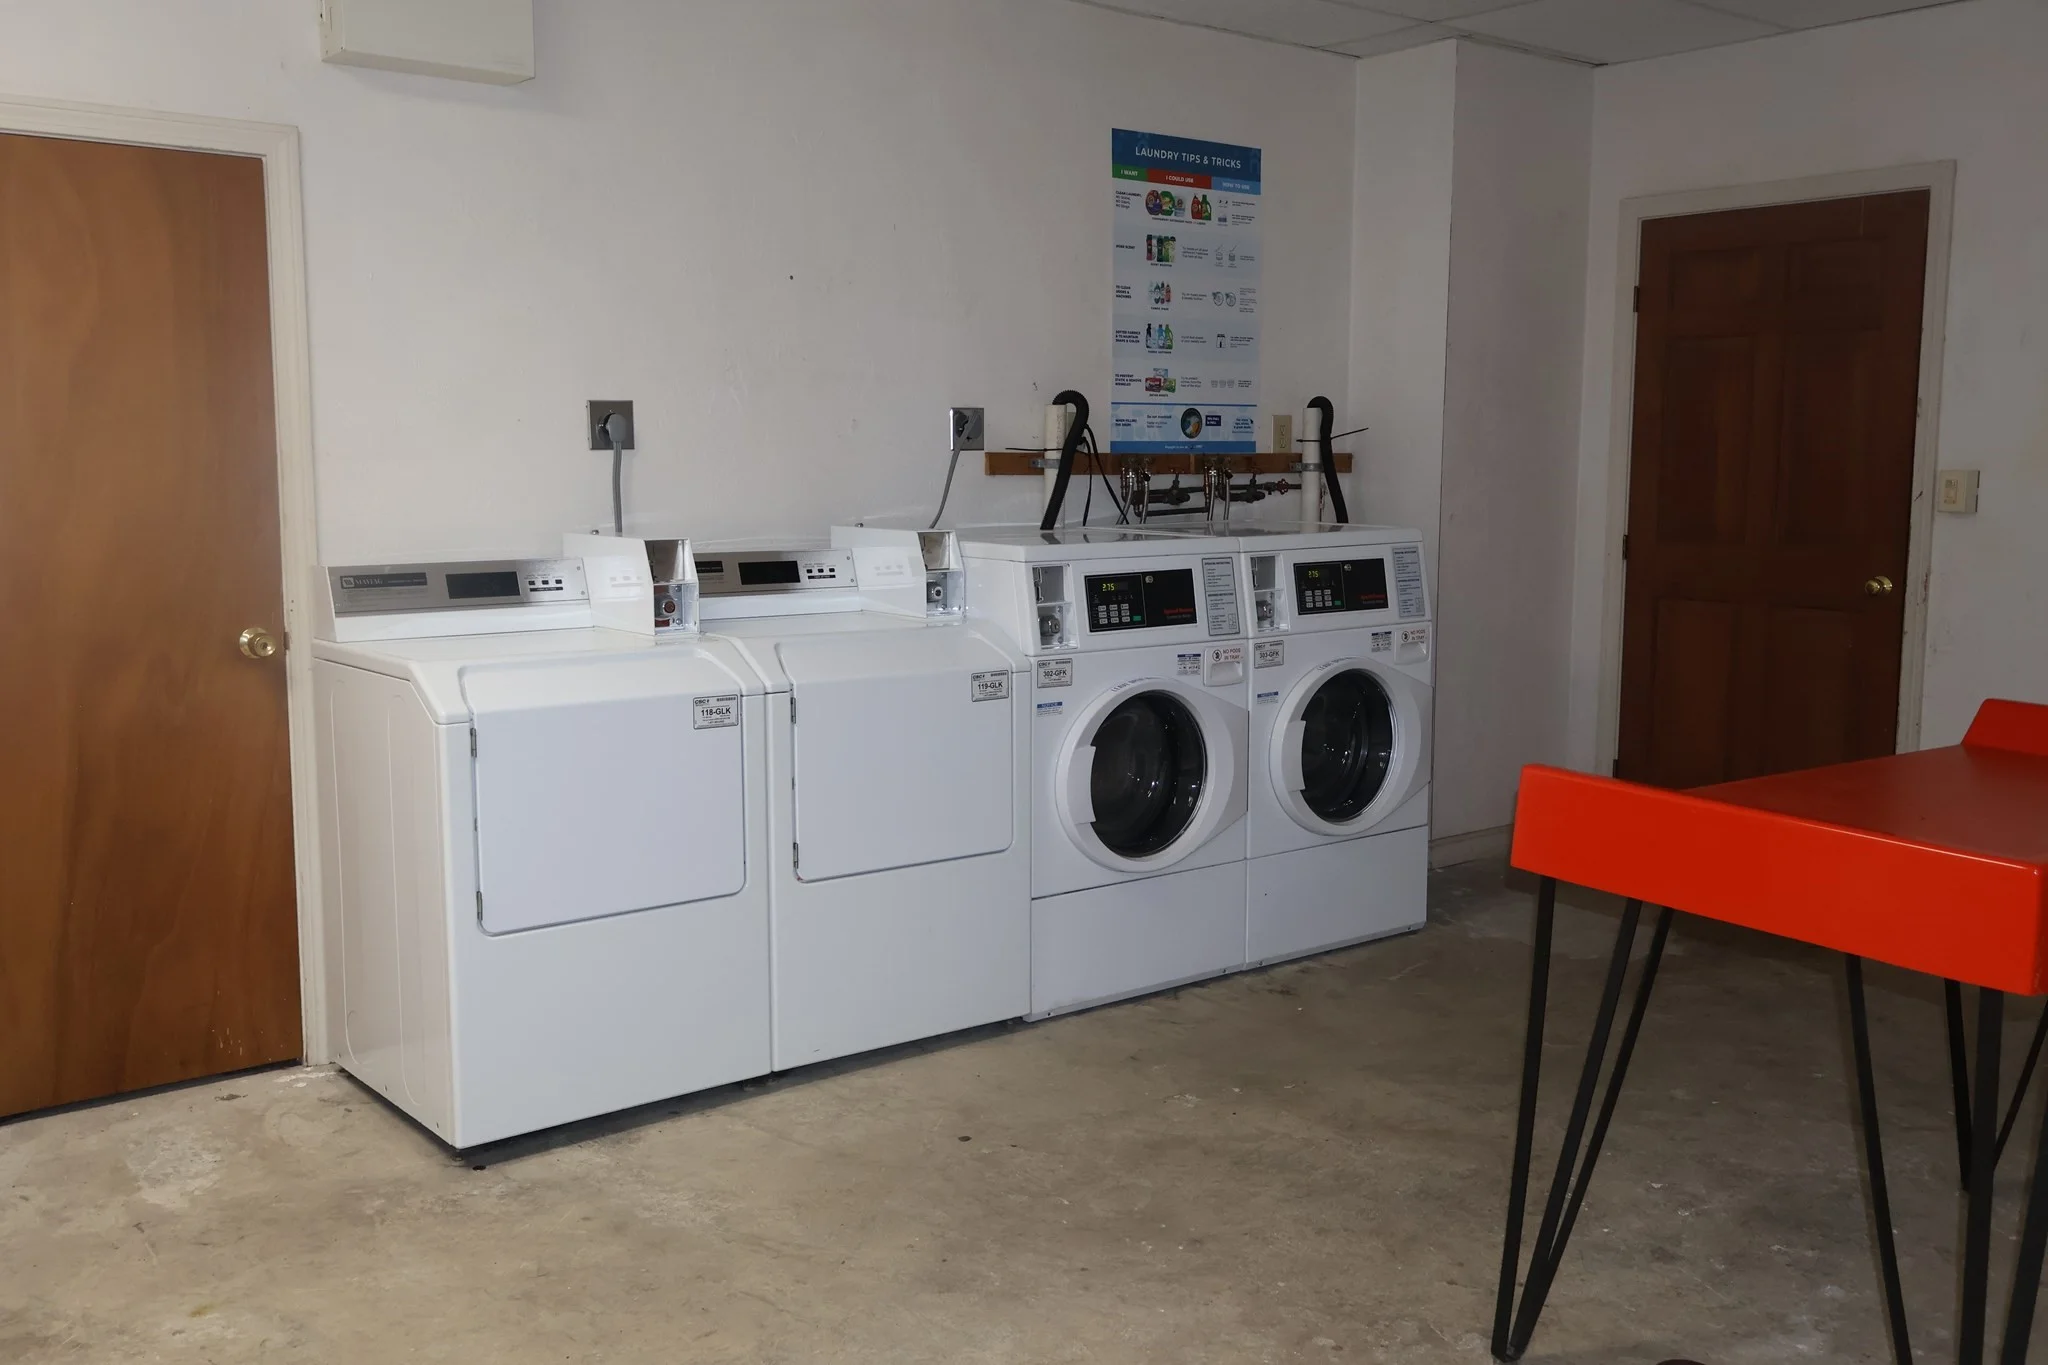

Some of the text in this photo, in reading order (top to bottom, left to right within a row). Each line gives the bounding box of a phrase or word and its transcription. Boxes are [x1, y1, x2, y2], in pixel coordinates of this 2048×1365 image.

[1135, 146, 1241, 168] LAUNDRY TIPS & TRICKS
[978, 681, 1003, 689] 119-GLK
[701, 707, 731, 716] 118-GLK
